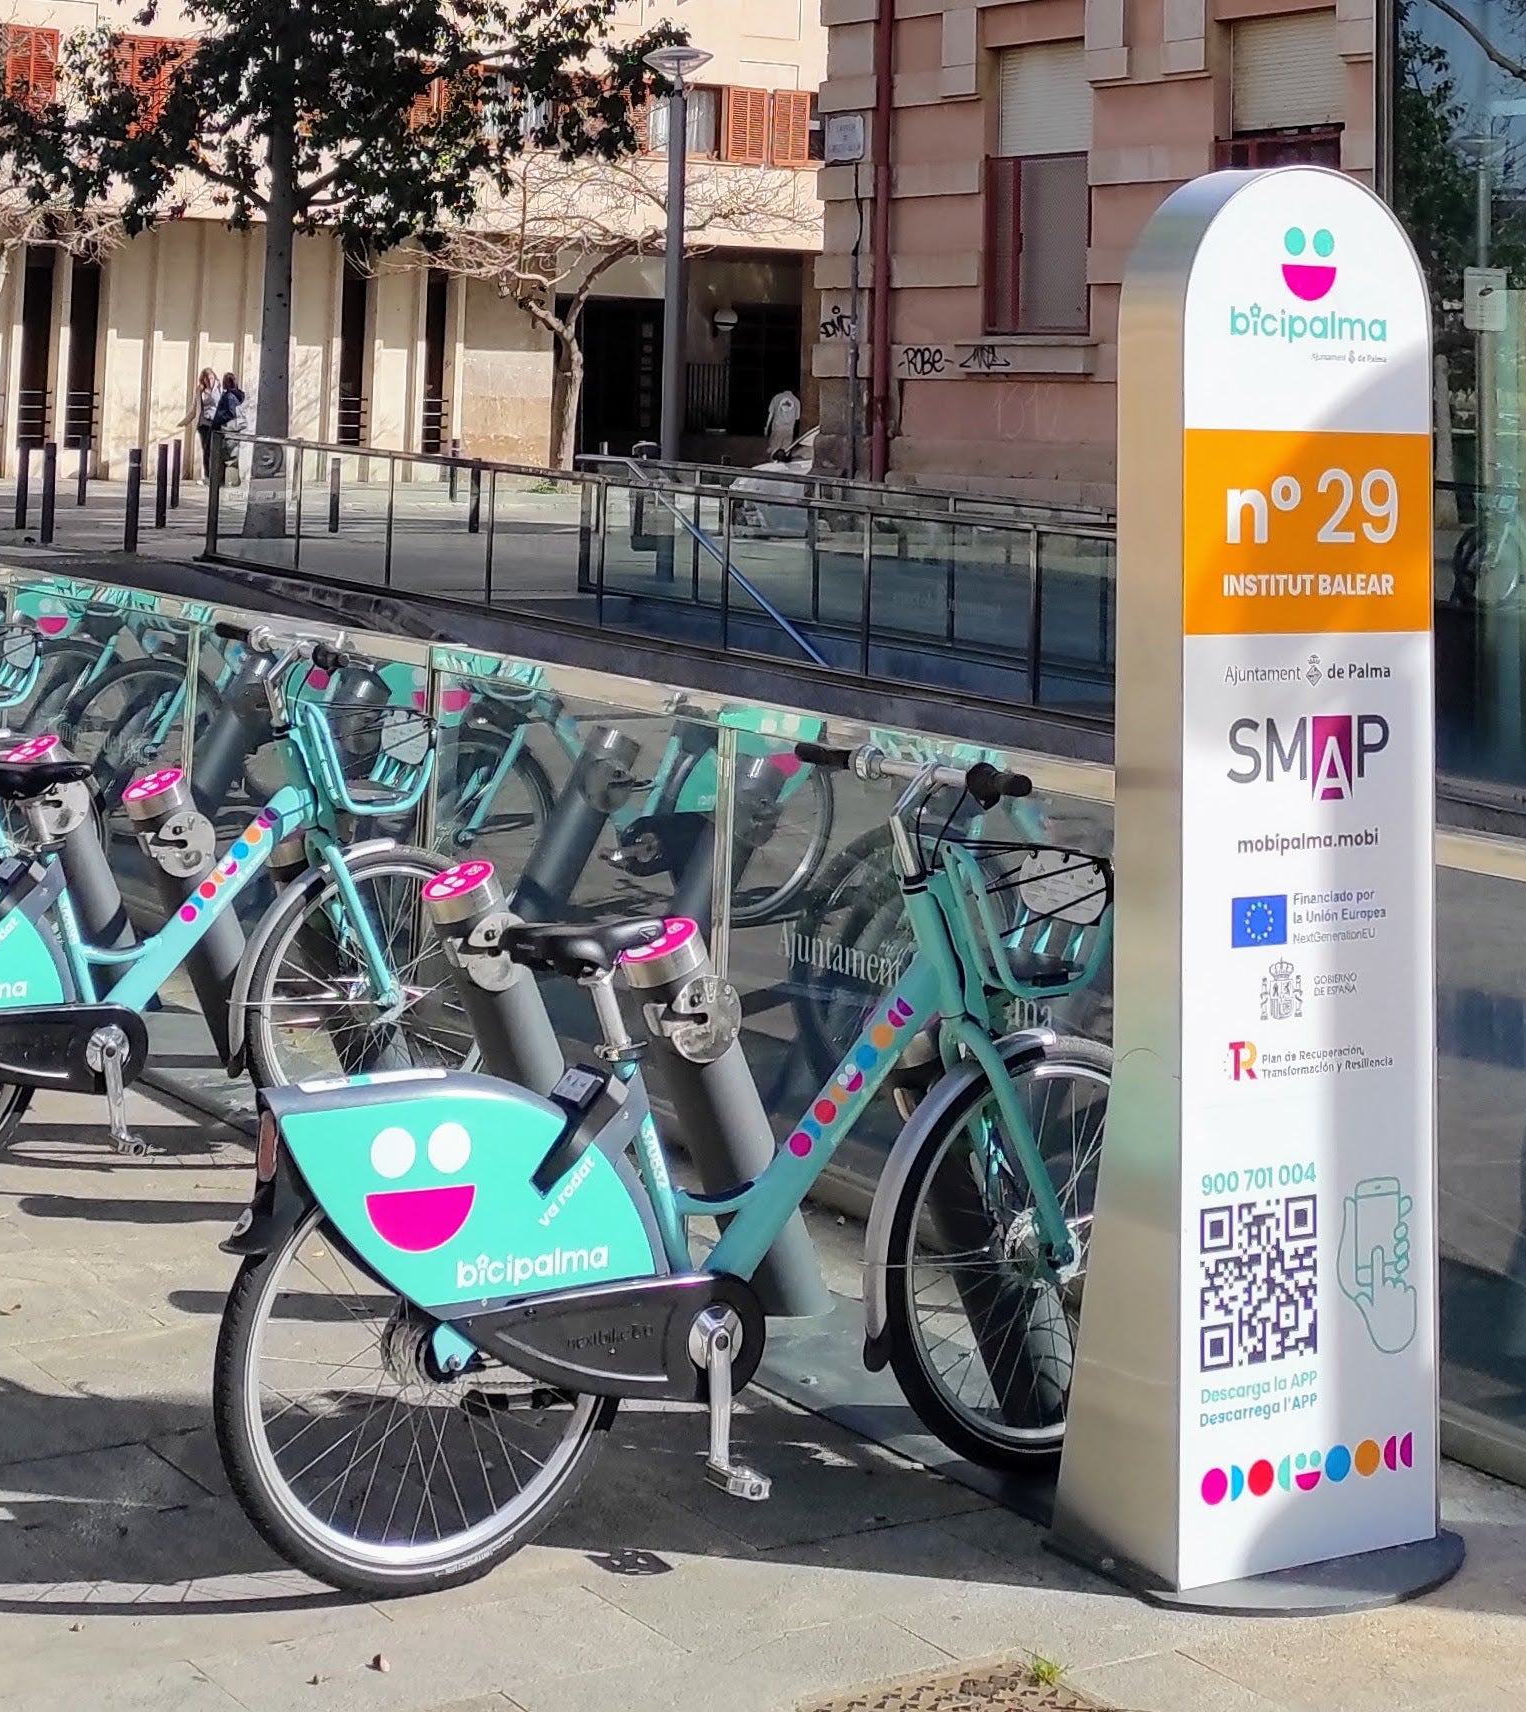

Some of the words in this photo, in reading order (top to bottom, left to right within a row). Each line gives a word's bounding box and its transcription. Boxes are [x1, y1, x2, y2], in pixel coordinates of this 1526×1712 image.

[1230, 302, 1387, 343] bicipalma
[1316, 468, 1399, 544] 29
[1223, 574, 1314, 597] INSTITUT
[1318, 574, 1394, 596] BALEAR
[1225, 665, 1301, 686] Ajuntament
[1327, 664, 1345, 679] de
[1348, 663, 1391, 679] Palma
[1226, 714, 1390, 801] SMAP
[1237, 828, 1379, 856] mobipalma.mobi
[1293, 890, 1354, 906] Financiado
[1356, 890, 1375, 905] por
[1293, 912, 1303, 924] la
[1306, 908, 1338, 924] Unión
[1341, 906, 1386, 922] Europea
[1293, 928, 1376, 945] NextGenerationEU
[1313, 972, 1358, 986] GOBIERNO
[1313, 986, 1325, 997] DE
[1326, 982, 1358, 996] ESPAÑA
[1262, 1052, 1282, 1065] Plan
[1285, 1051, 1297, 1062] de
[1262, 1061, 1335, 1079] Transformación
[1345, 1056, 1394, 1071] Resiliencia
[538, 1199, 560, 1227] va
[558, 1155, 597, 1207] rodat
[1201, 1171, 1239, 1196] 900
[1244, 1167, 1274, 1191] 701
[1278, 1162, 1317, 1186] 004
[456, 1245, 609, 1289] bicipalma
[1200, 1380, 1270, 1405] Descarga
[1274, 1375, 1288, 1392] la
[1290, 1370, 1318, 1390] APP
[1199, 1399, 1281, 1428] Descarrega
[1284, 1392, 1318, 1413] l'APP
